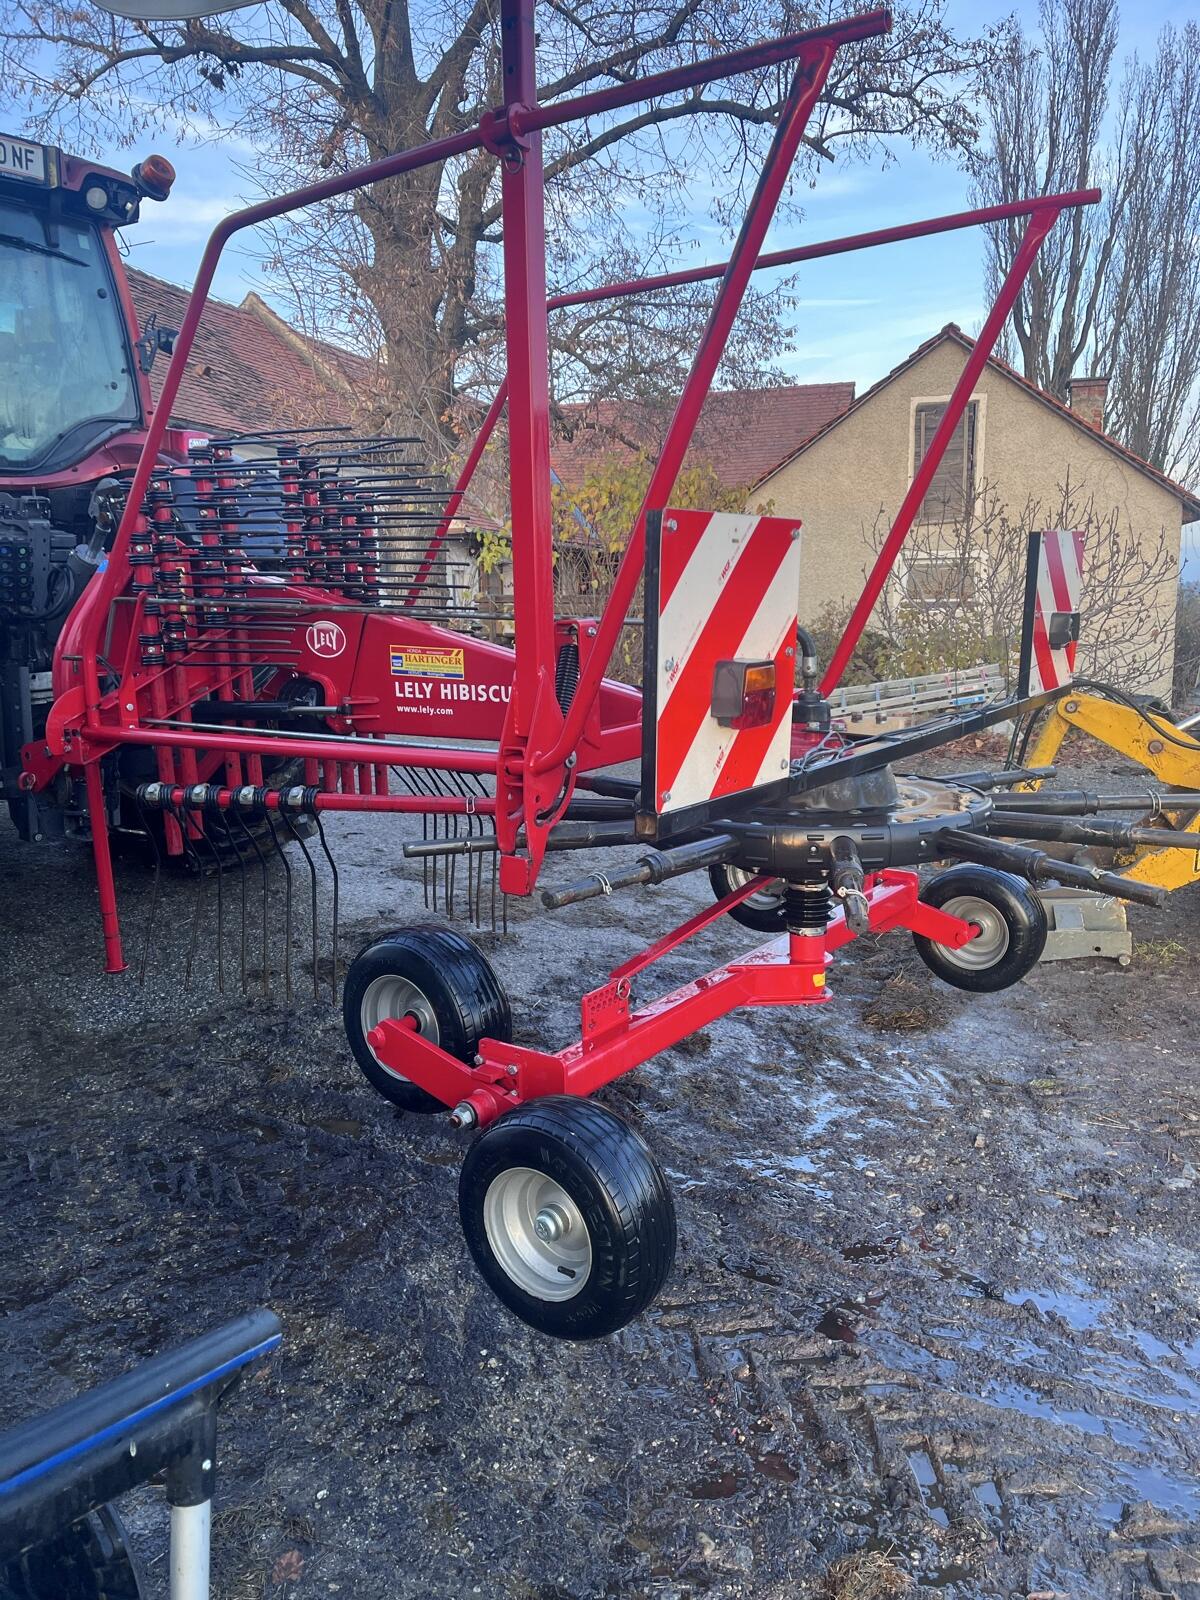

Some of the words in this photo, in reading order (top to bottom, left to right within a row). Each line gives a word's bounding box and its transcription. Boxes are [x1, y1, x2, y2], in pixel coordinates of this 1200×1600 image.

[313, 628, 337, 651] LELY
[404, 654, 462, 666] HARTINGER
[394, 681, 434, 699] LELY
[440, 683, 512, 703] HIBISCU
[396, 705, 454, 716] www.lely.com
